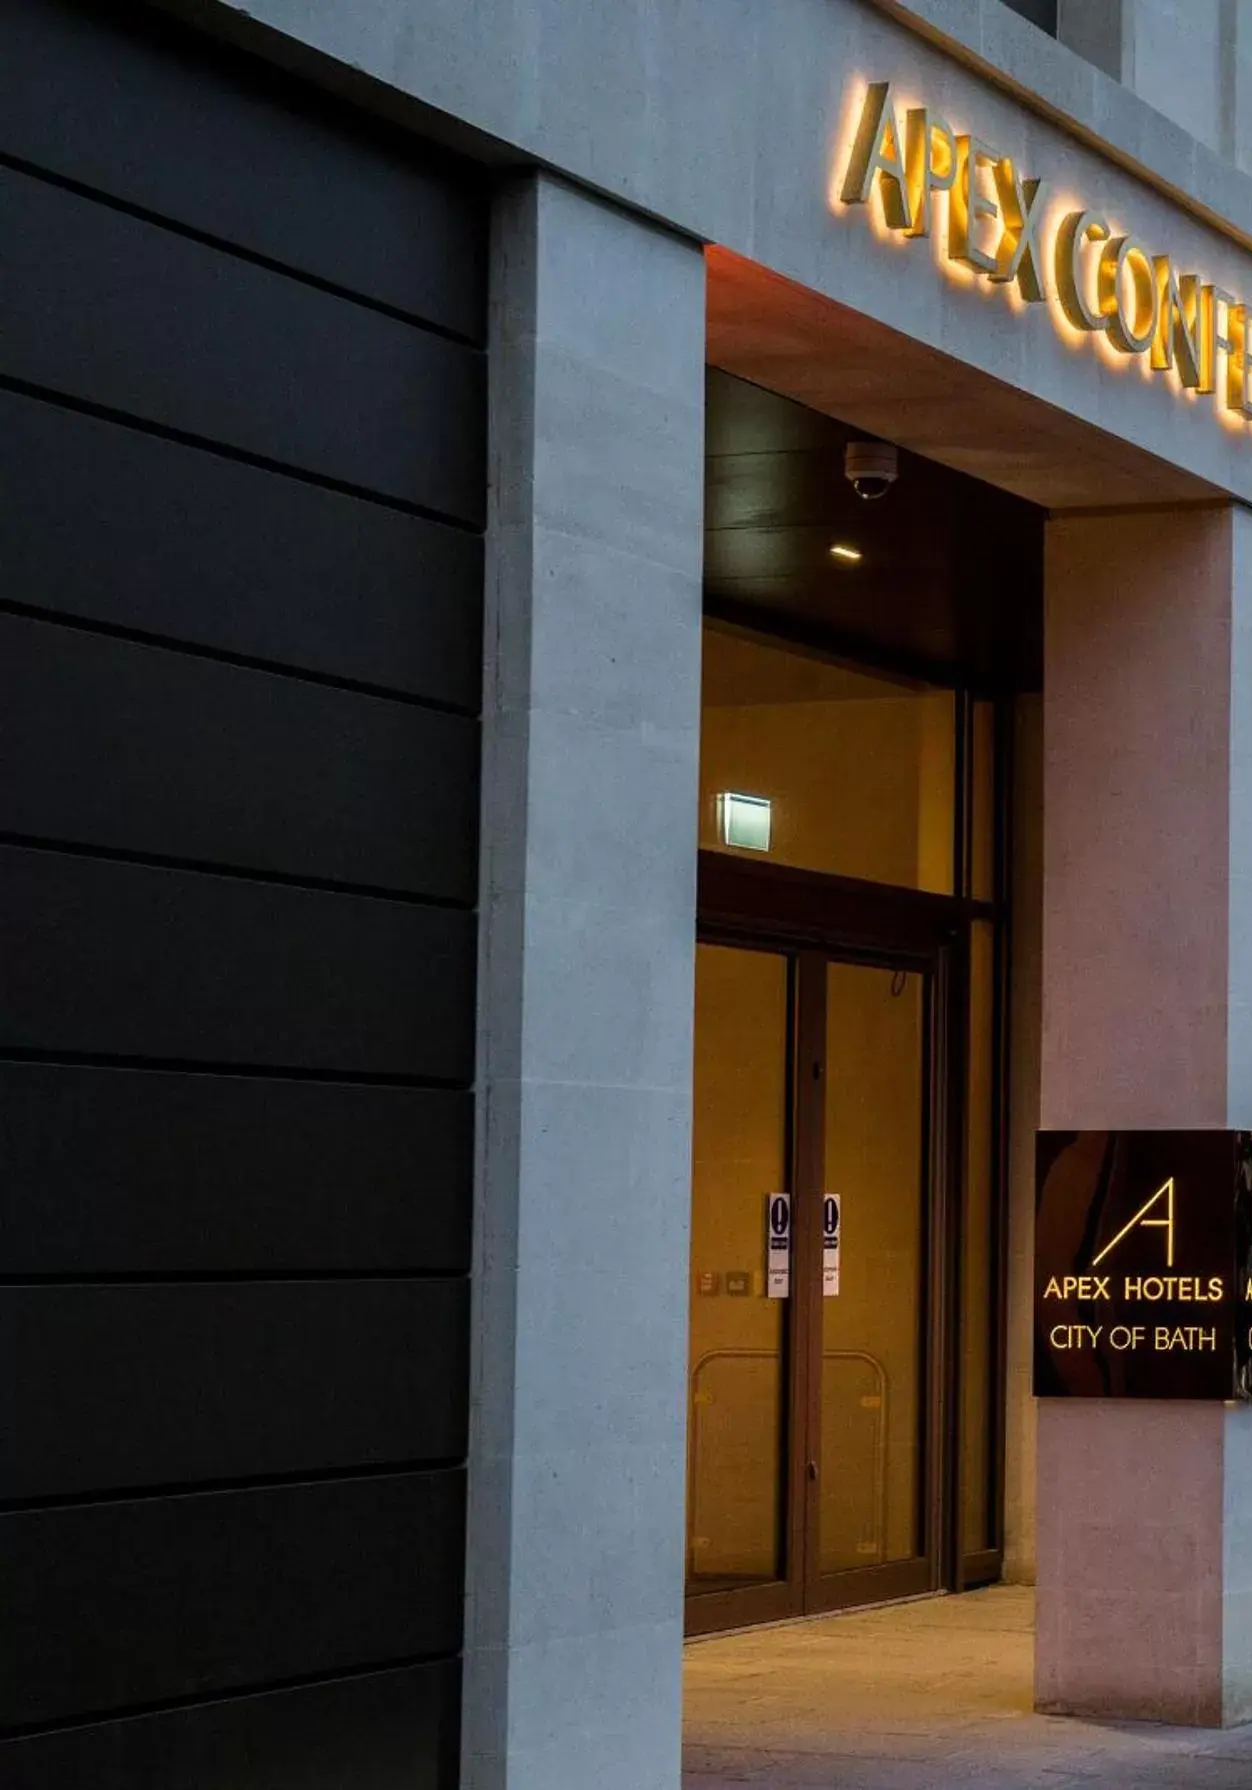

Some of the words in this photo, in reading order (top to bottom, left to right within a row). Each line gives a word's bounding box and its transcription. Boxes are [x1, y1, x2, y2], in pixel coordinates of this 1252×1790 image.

[840, 81, 1047, 302] APEX
[1043, 1276, 1110, 1300] APEX
[1124, 1277, 1223, 1300] HOTELS
[1050, 1325, 1102, 1348] CITY
[1110, 1326, 1145, 1349] OF
[1155, 1326, 1216, 1350] BATH
